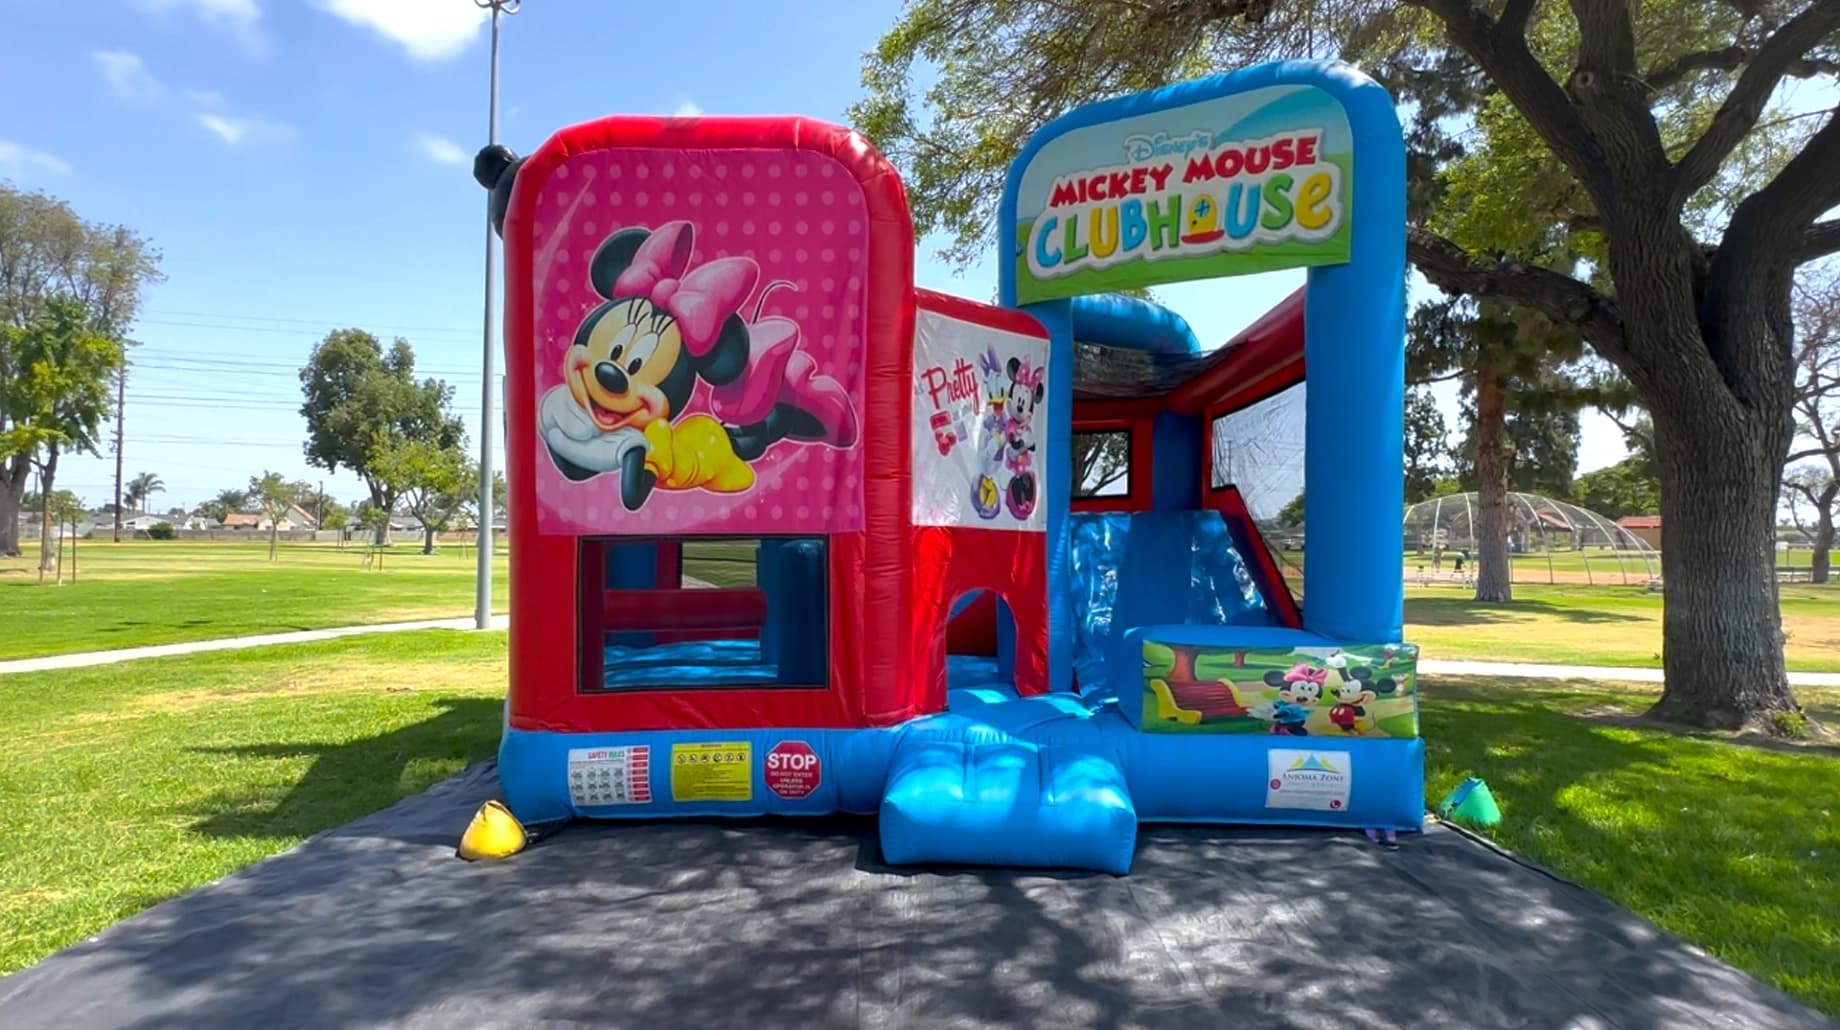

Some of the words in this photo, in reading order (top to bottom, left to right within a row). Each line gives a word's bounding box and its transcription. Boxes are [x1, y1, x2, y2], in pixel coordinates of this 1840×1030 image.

[1049, 162, 1174, 208] MICKEY
[1182, 135, 1319, 184] MOUSE
[920, 357, 980, 416] Pretty
[767, 753, 817, 770] STOP
